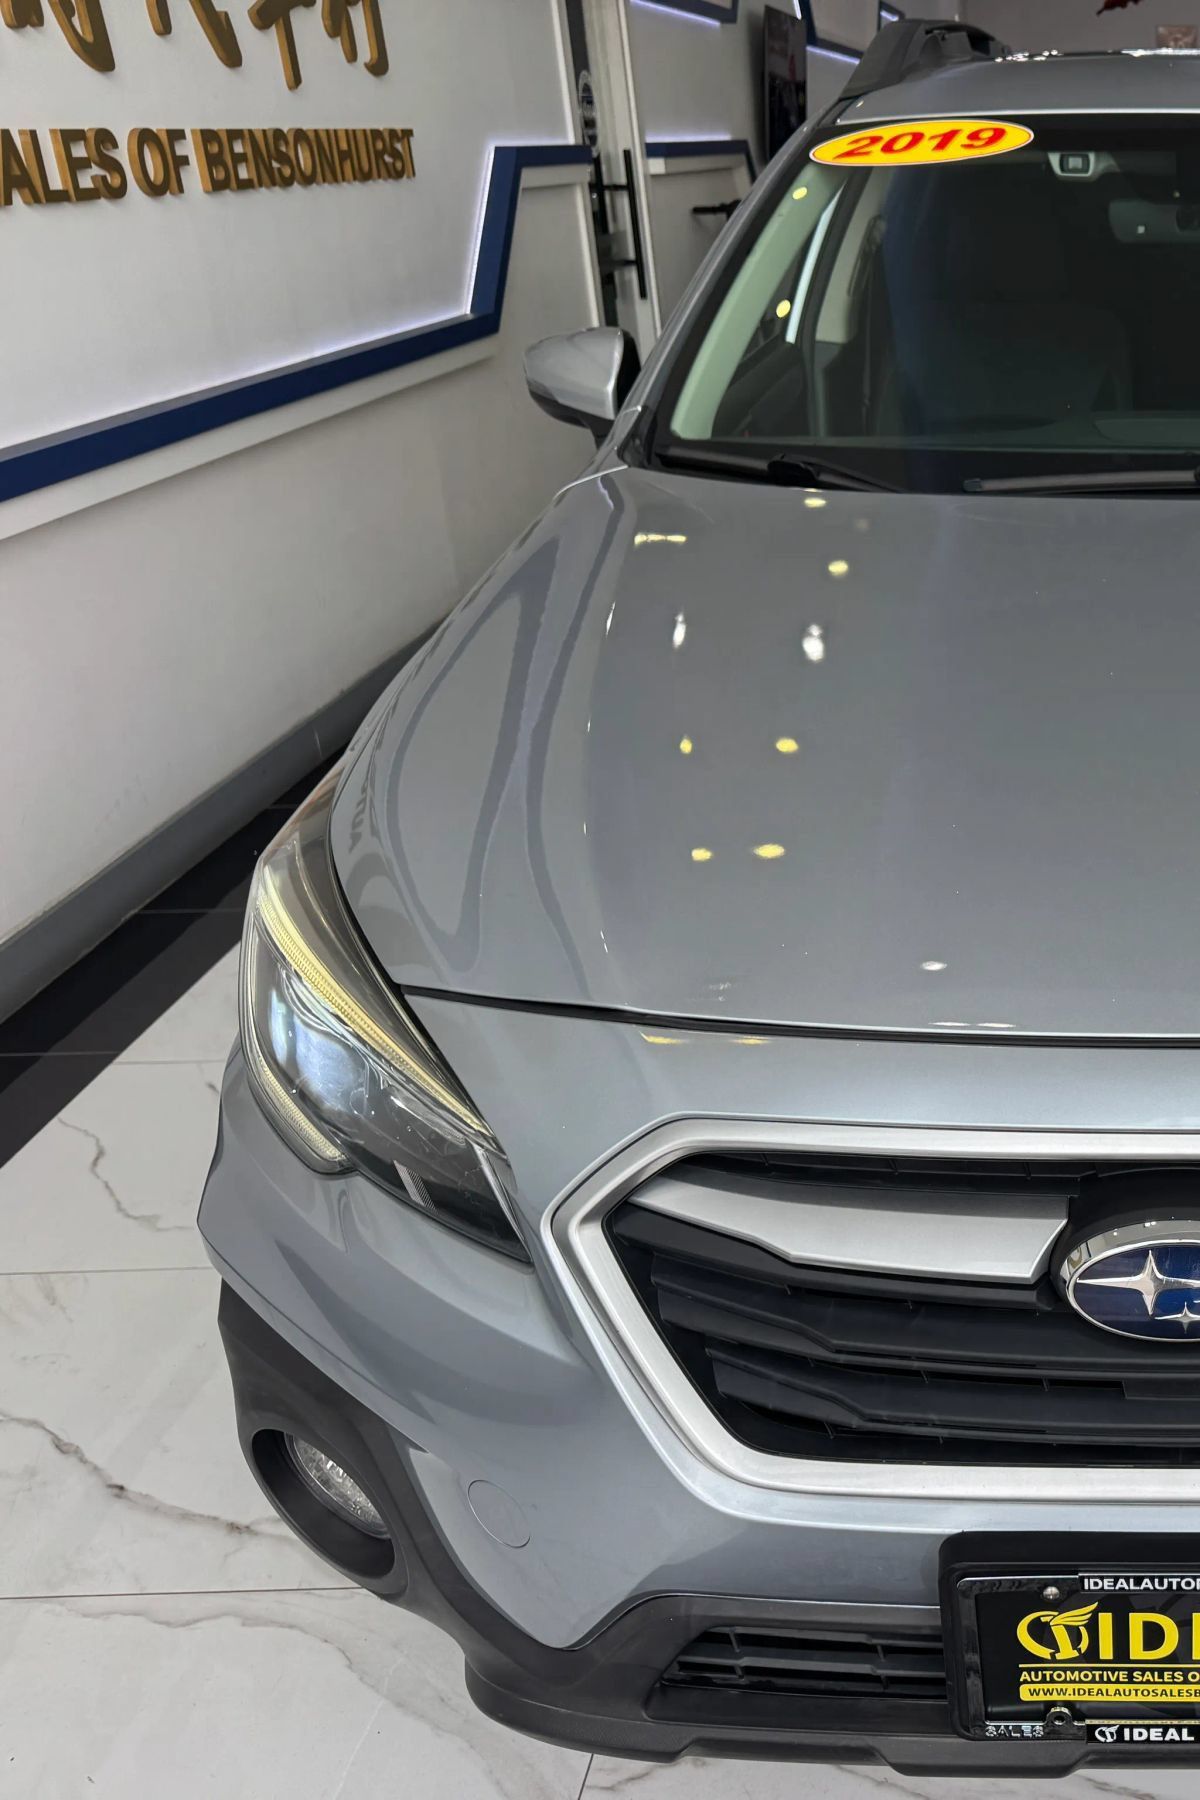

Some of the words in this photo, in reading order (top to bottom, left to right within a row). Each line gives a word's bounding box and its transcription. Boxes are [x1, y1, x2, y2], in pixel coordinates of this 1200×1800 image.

[832, 127, 1007, 160] 2019
[127, 127, 190, 197] OF
[191, 127, 416, 193] BENSONHURST
[1019, 1670, 1129, 1683] AUTOMOTIVE
[1132, 1670, 1184, 1683] SALES
[985, 1725, 1044, 1738] SALES
[1123, 1727, 1195, 1742] IDEAL
